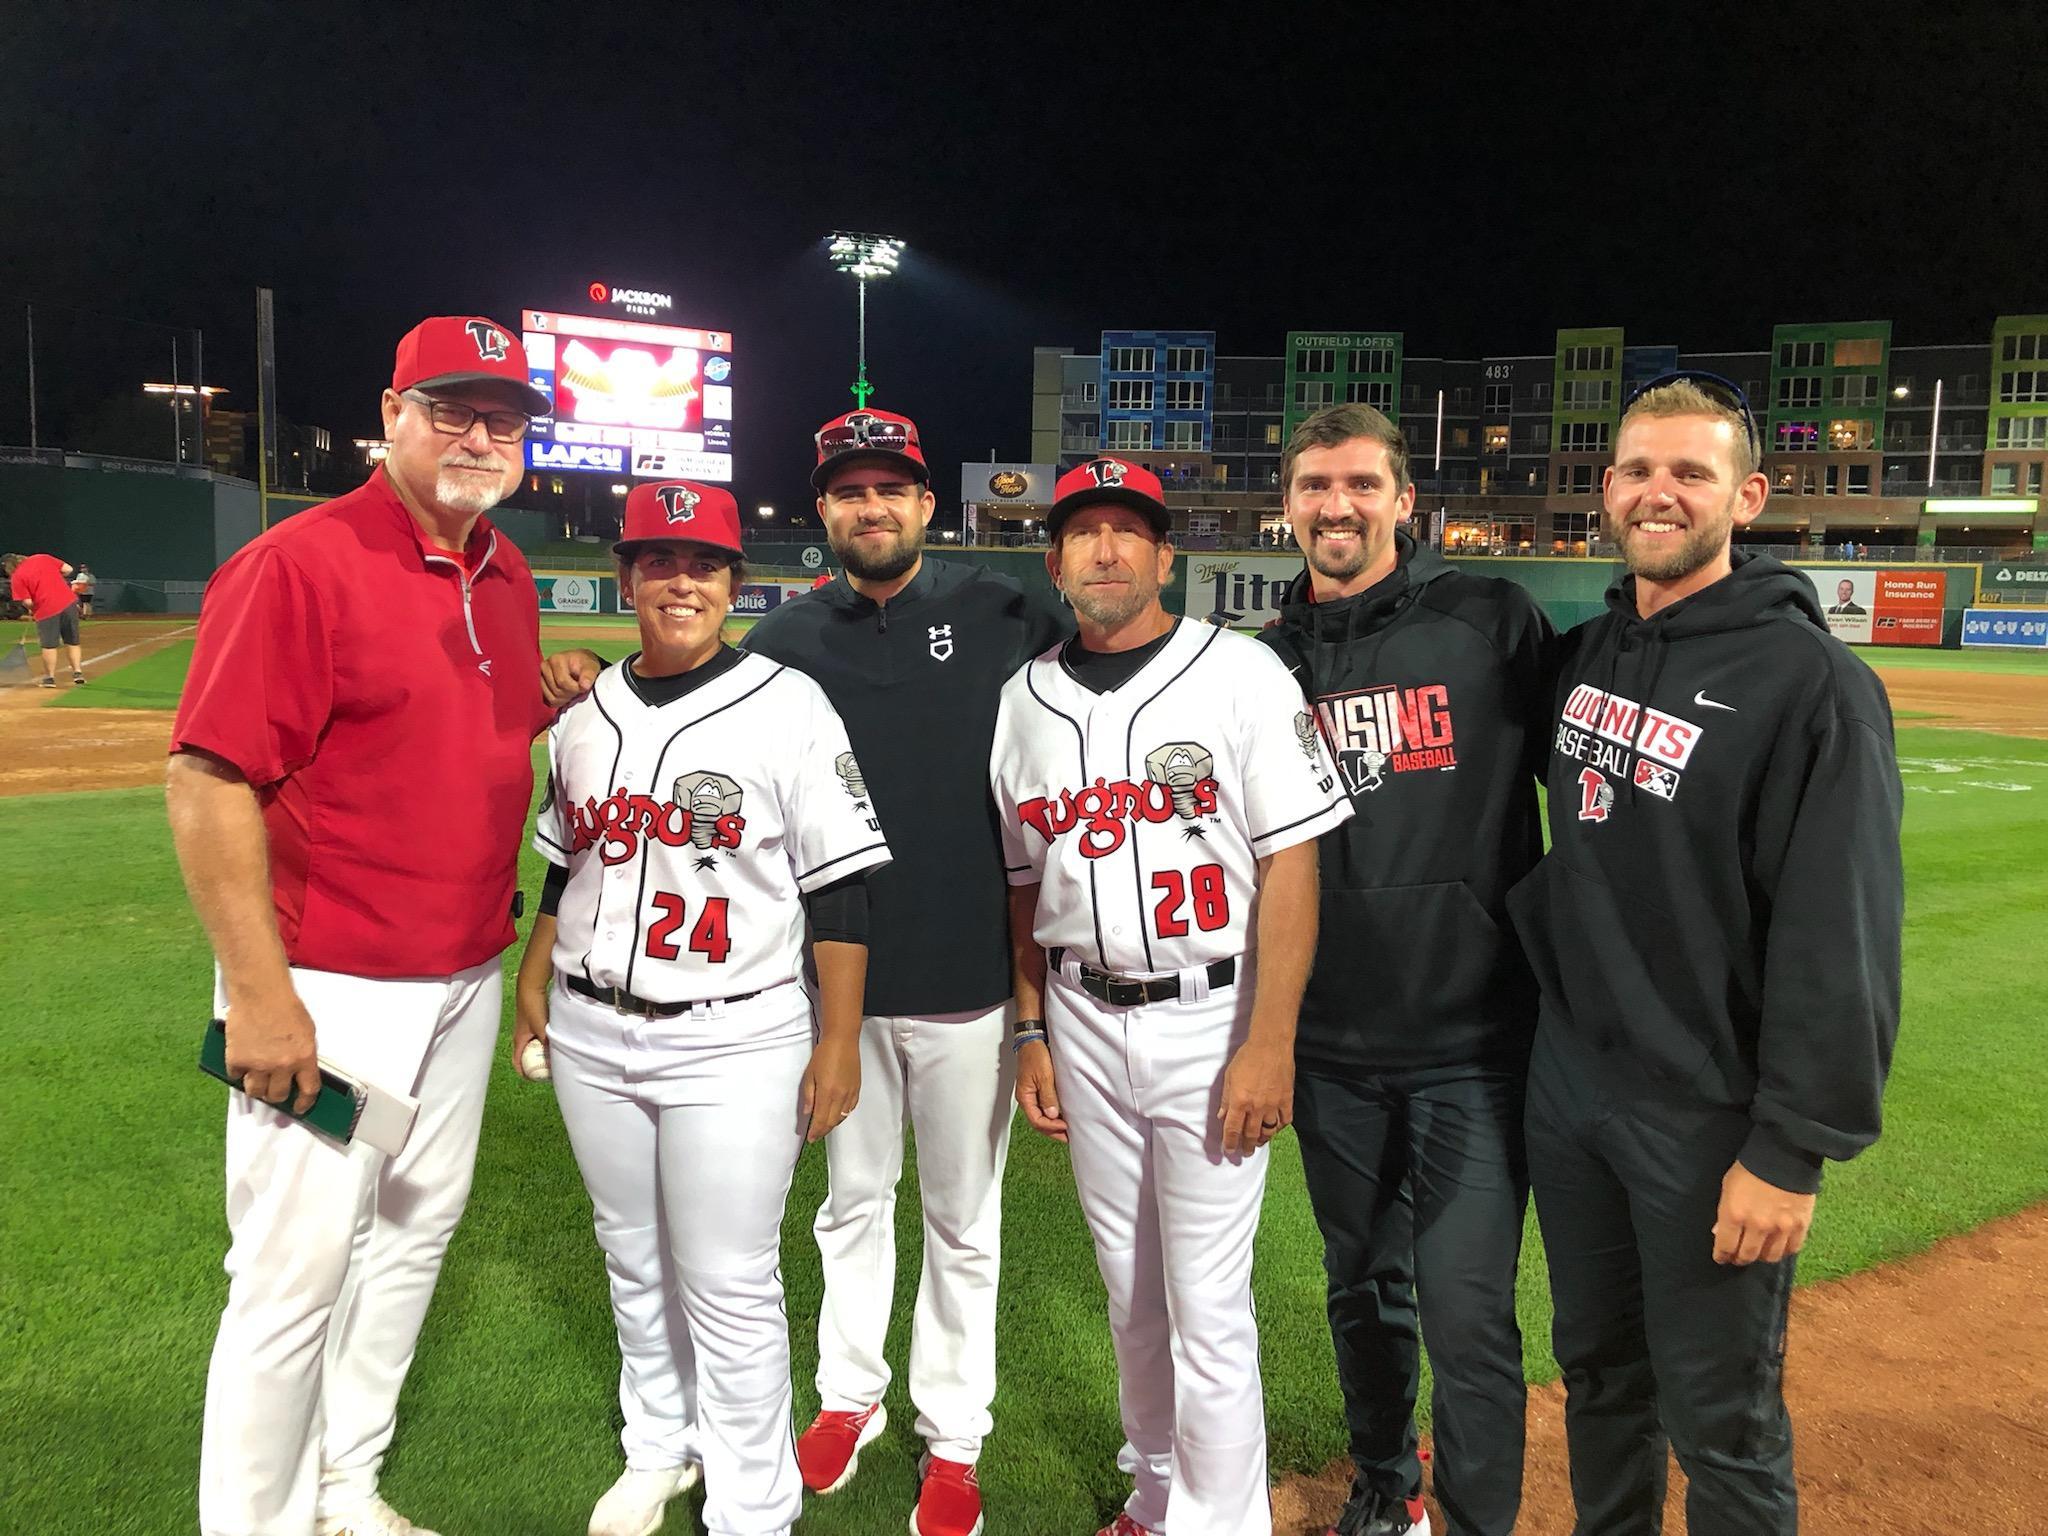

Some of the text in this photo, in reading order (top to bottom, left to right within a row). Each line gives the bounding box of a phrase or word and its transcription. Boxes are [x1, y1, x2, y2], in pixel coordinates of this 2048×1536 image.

[611, 288, 672, 308] JACKSON
[626, 304, 656, 315] FIELD
[1295, 337, 1394, 347] OUTFIELD LOFTS
[994, 473, 1017, 489] Good
[1000, 484, 1023, 495] Hops
[804, 551, 820, 564] 42
[1194, 561, 1240, 584] Miller
[2015, 570, 2048, 582] DELT
[1884, 581, 1937, 590] Home Run
[735, 594, 767, 609] Blue
[1210, 571, 1294, 622] Lite
[1885, 590, 1935, 599] Insurance
[1980, 593, 2000, 602] 407
[1392, 747, 1457, 773] BASEBALL
[1151, 863, 1230, 939] 28
[645, 891, 731, 963] 24
